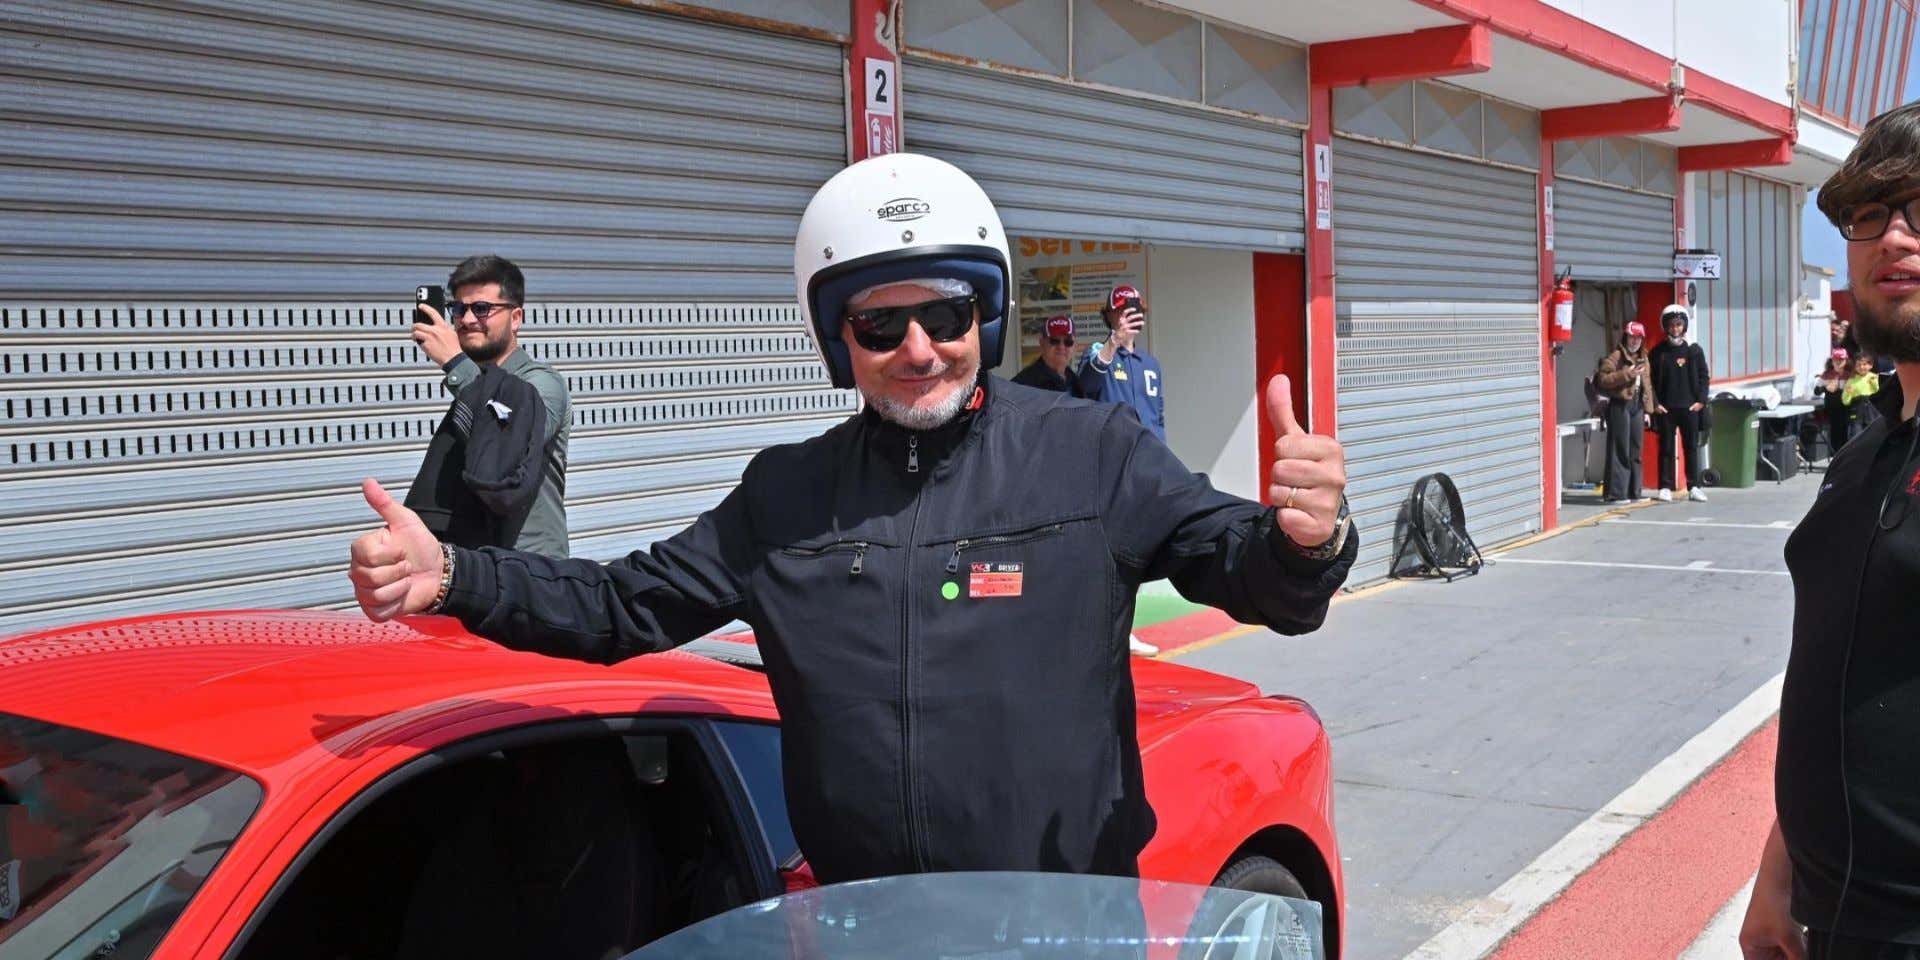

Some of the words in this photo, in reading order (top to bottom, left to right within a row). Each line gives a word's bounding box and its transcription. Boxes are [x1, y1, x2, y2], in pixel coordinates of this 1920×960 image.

[875, 69, 888, 103] 2
[1320, 151, 1325, 173] 1
[1144, 370, 1158, 397] C
